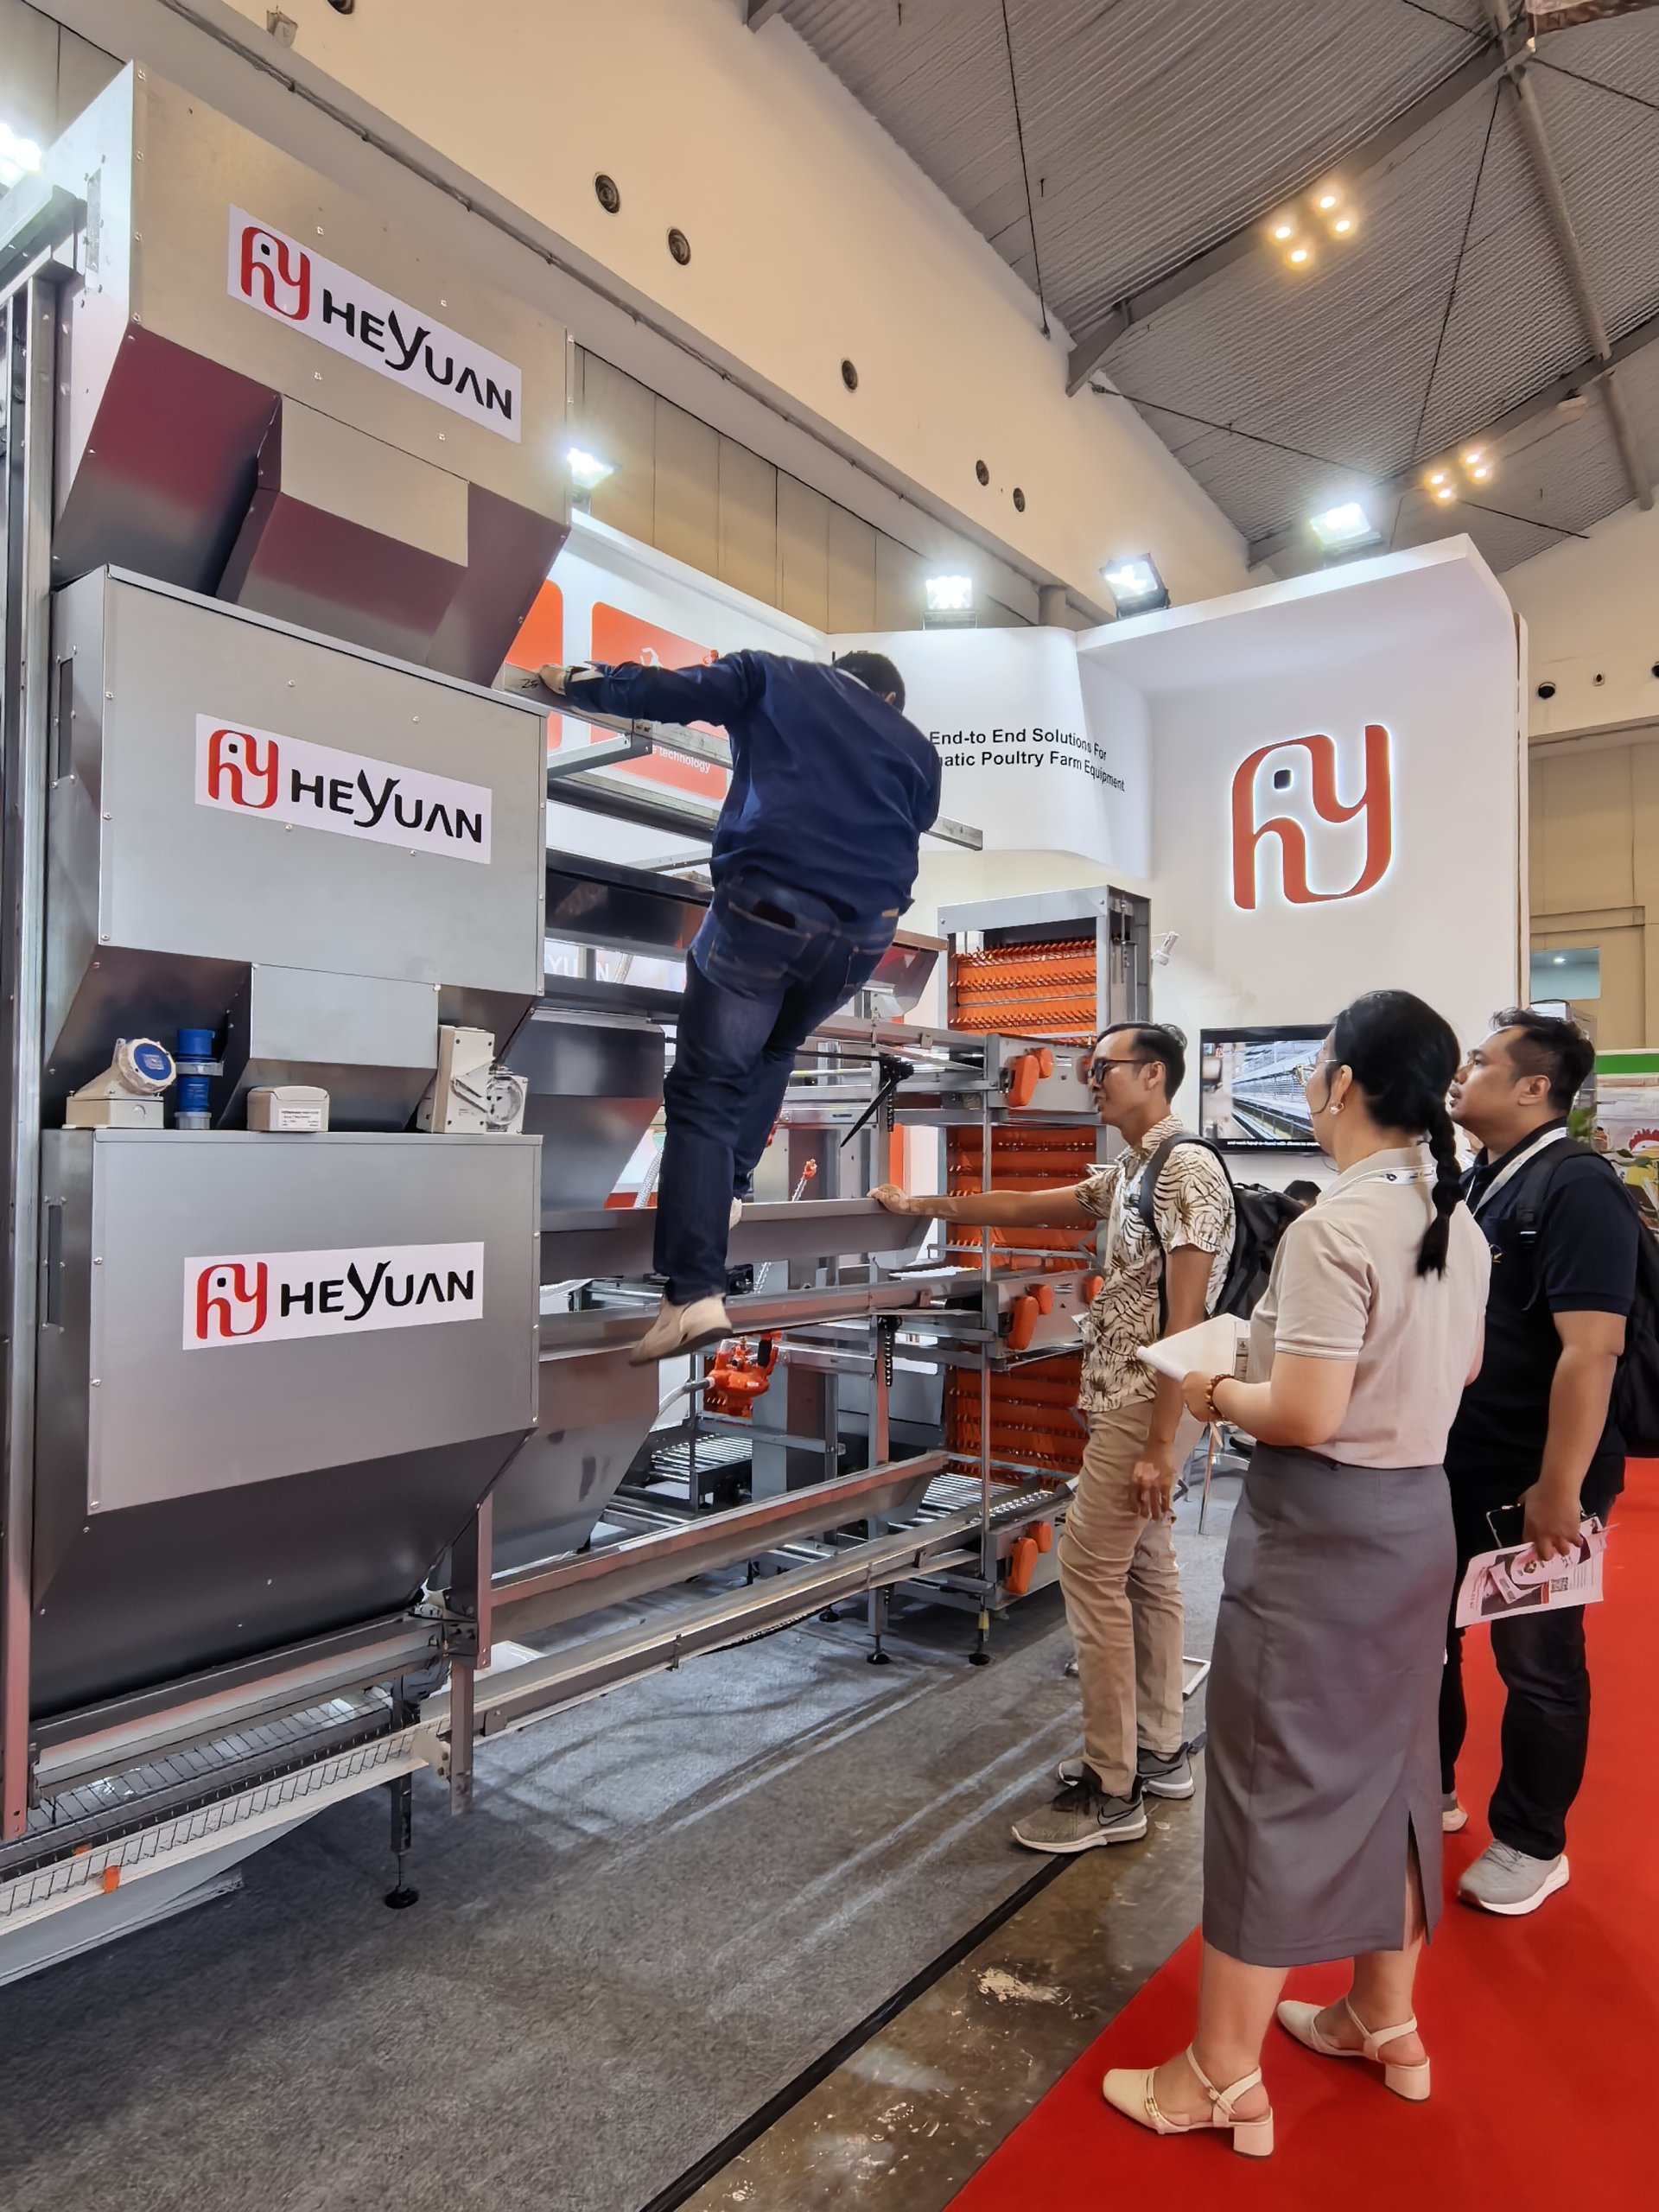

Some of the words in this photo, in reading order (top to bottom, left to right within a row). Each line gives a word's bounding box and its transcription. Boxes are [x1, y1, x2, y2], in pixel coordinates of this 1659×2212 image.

[322, 289, 512, 422] HEYUAN
[658, 746, 710, 773] technology
[930, 731, 986, 745] End-to
[993, 728, 1027, 743] End
[1033, 728, 1091, 753] Solutions
[1094, 742, 1107, 760] For
[982, 751, 1044, 767] Poultry
[1050, 751, 1082, 770] Farm
[1084, 760, 1125, 791] Equipment
[291, 768, 482, 843] HEYUAN
[281, 1261, 474, 1321] HEYUAN
